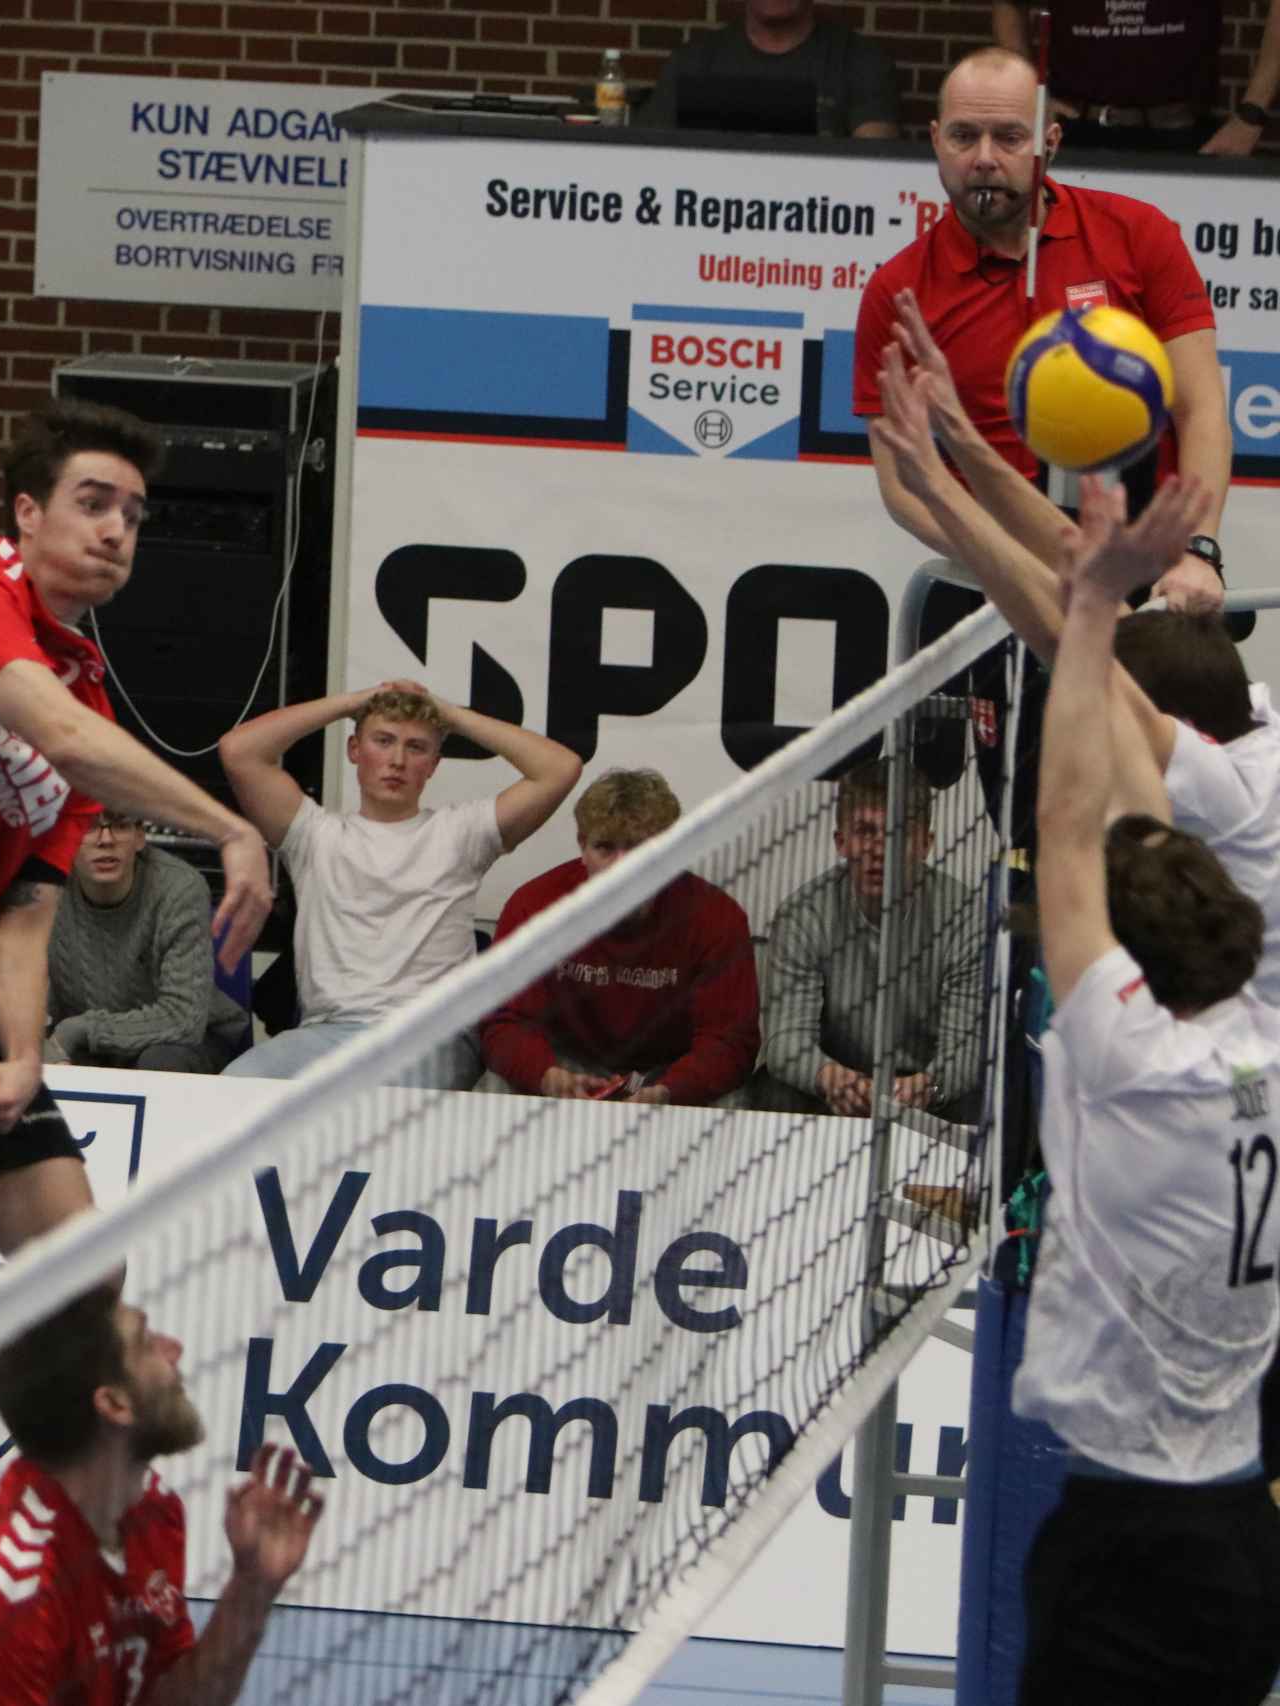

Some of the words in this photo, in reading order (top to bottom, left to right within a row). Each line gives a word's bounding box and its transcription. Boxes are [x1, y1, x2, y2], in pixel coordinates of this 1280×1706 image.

[132, 102, 209, 135] KUN
[117, 208, 332, 239] OVERTRÆDELSE
[486, 179, 623, 223] Service
[635, 186, 661, 225] &
[675, 189, 874, 235] Reparation
[1194, 221, 1239, 259] og
[116, 245, 296, 274] BORTVISNING
[699, 254, 823, 290] Udlejning
[832, 260, 866, 289] af:
[650, 334, 782, 370] BOSCH
[649, 372, 780, 405] Service
[1229, 1134, 1278, 1288] 12
[254, 1165, 749, 1333] Varde
